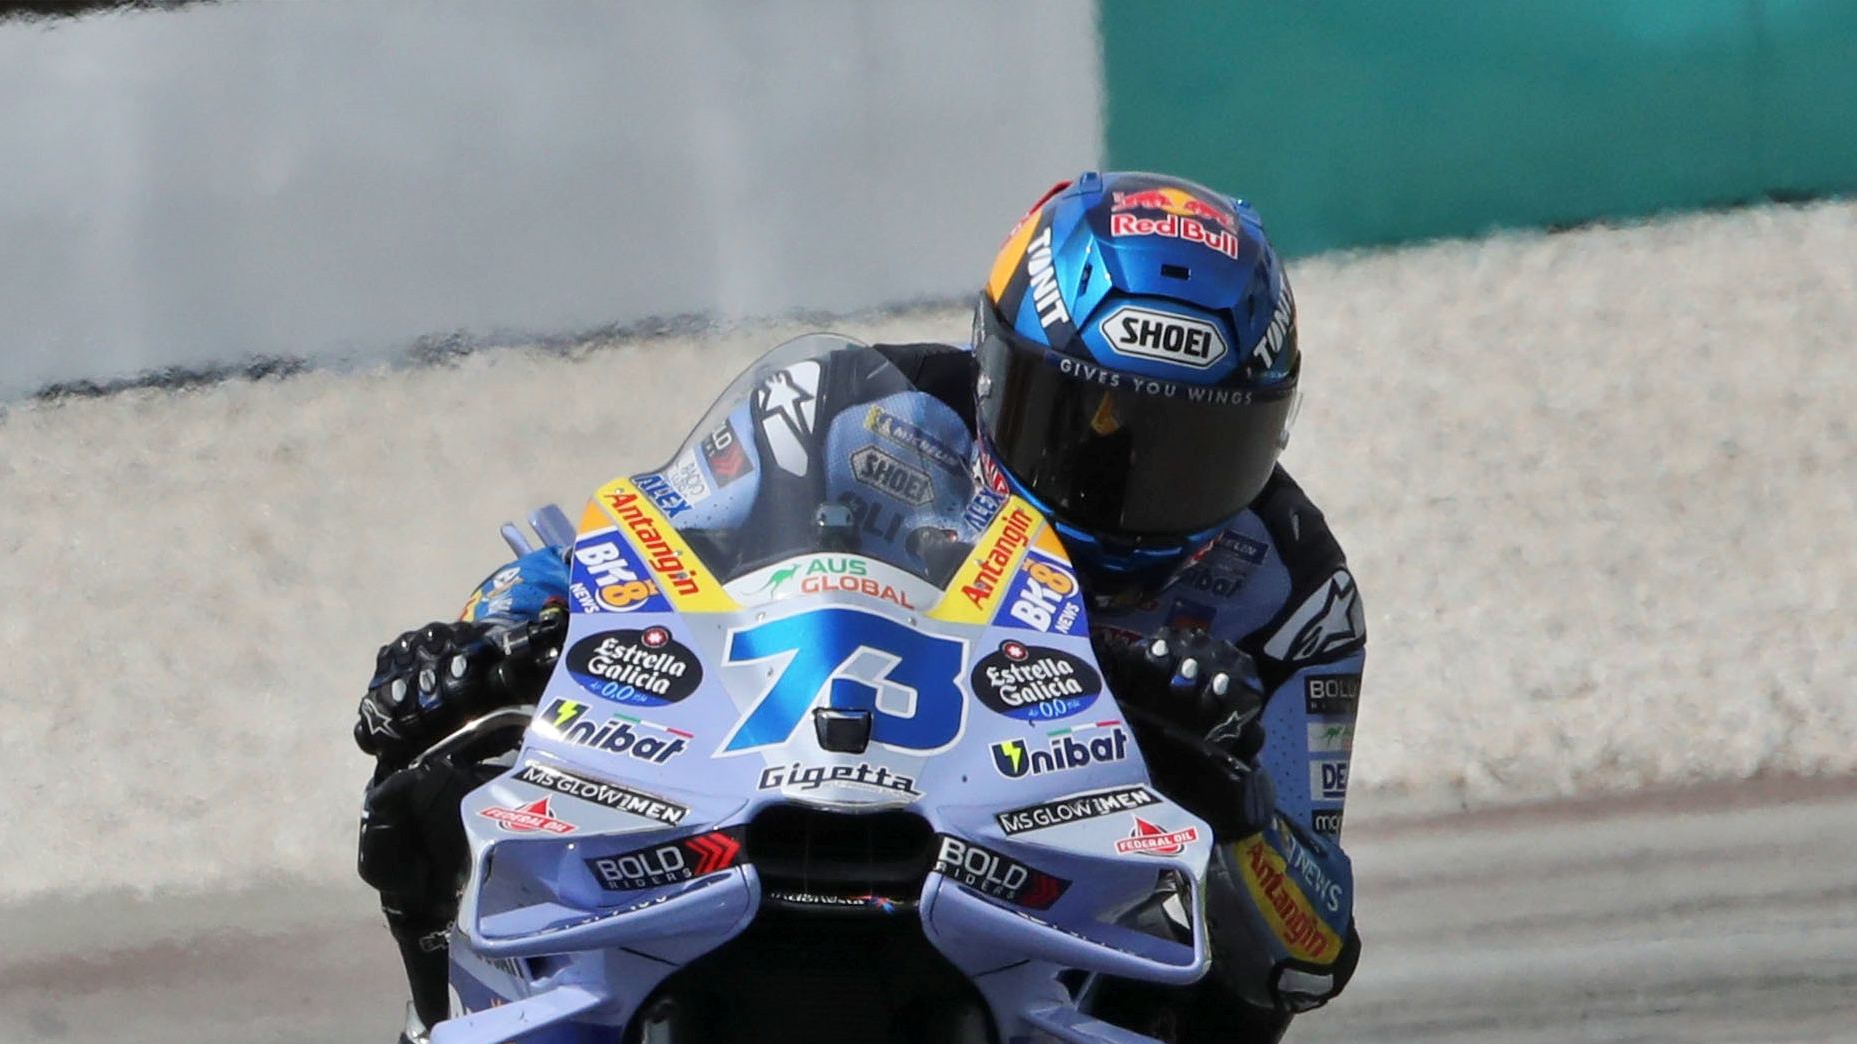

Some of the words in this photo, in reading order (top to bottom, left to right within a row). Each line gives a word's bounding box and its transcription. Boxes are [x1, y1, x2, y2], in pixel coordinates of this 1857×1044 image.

[1111, 214, 1176, 237] Red
[1180, 217, 1238, 259] Bull
[1028, 227, 1070, 328] TONIT
[1120, 317, 1211, 358] SHOEI
[1060, 359, 1120, 387] GIVES
[1132, 377, 1176, 396] YOU
[1188, 386, 1253, 405] WINGS
[863, 452, 927, 498] SHOEI
[635, 474, 692, 519] ALEX
[964, 486, 1000, 532] ALEX
[605, 489, 699, 596] Antangin
[961, 507, 1033, 610] Antangin
[575, 542, 649, 607] BK8
[806, 559, 867, 576] AUS
[569, 582, 600, 613] NEWS
[801, 577, 914, 608] GLOBAL
[1010, 562, 1079, 632] BK8
[1055, 602, 1080, 634] NEWS
[588, 656, 670, 694] Galicia
[594, 637, 686, 677] Estrella
[986, 658, 1074, 687] Estrella
[1000, 677, 1083, 706] Galicia
[991, 728, 1128, 778] Unibat
[759, 763, 921, 795] Gigetta
[484, 807, 543, 828] FEDERAL
[544, 820, 567, 832] OIL
[556, 777, 623, 807] GLOW
[629, 798, 686, 824] MEN
[1032, 797, 1094, 829] GLOW
[1103, 790, 1151, 811] MEN
[1120, 837, 1172, 850] FEDERAL
[1174, 831, 1193, 842] OIL
[596, 846, 686, 882] BOLD
[608, 867, 692, 890] RIDERS
[935, 861, 1014, 899] RIDERS
[939, 837, 1028, 890] BOLD
[1295, 855, 1342, 911] NEWS
[1247, 844, 1328, 958] Antangin
